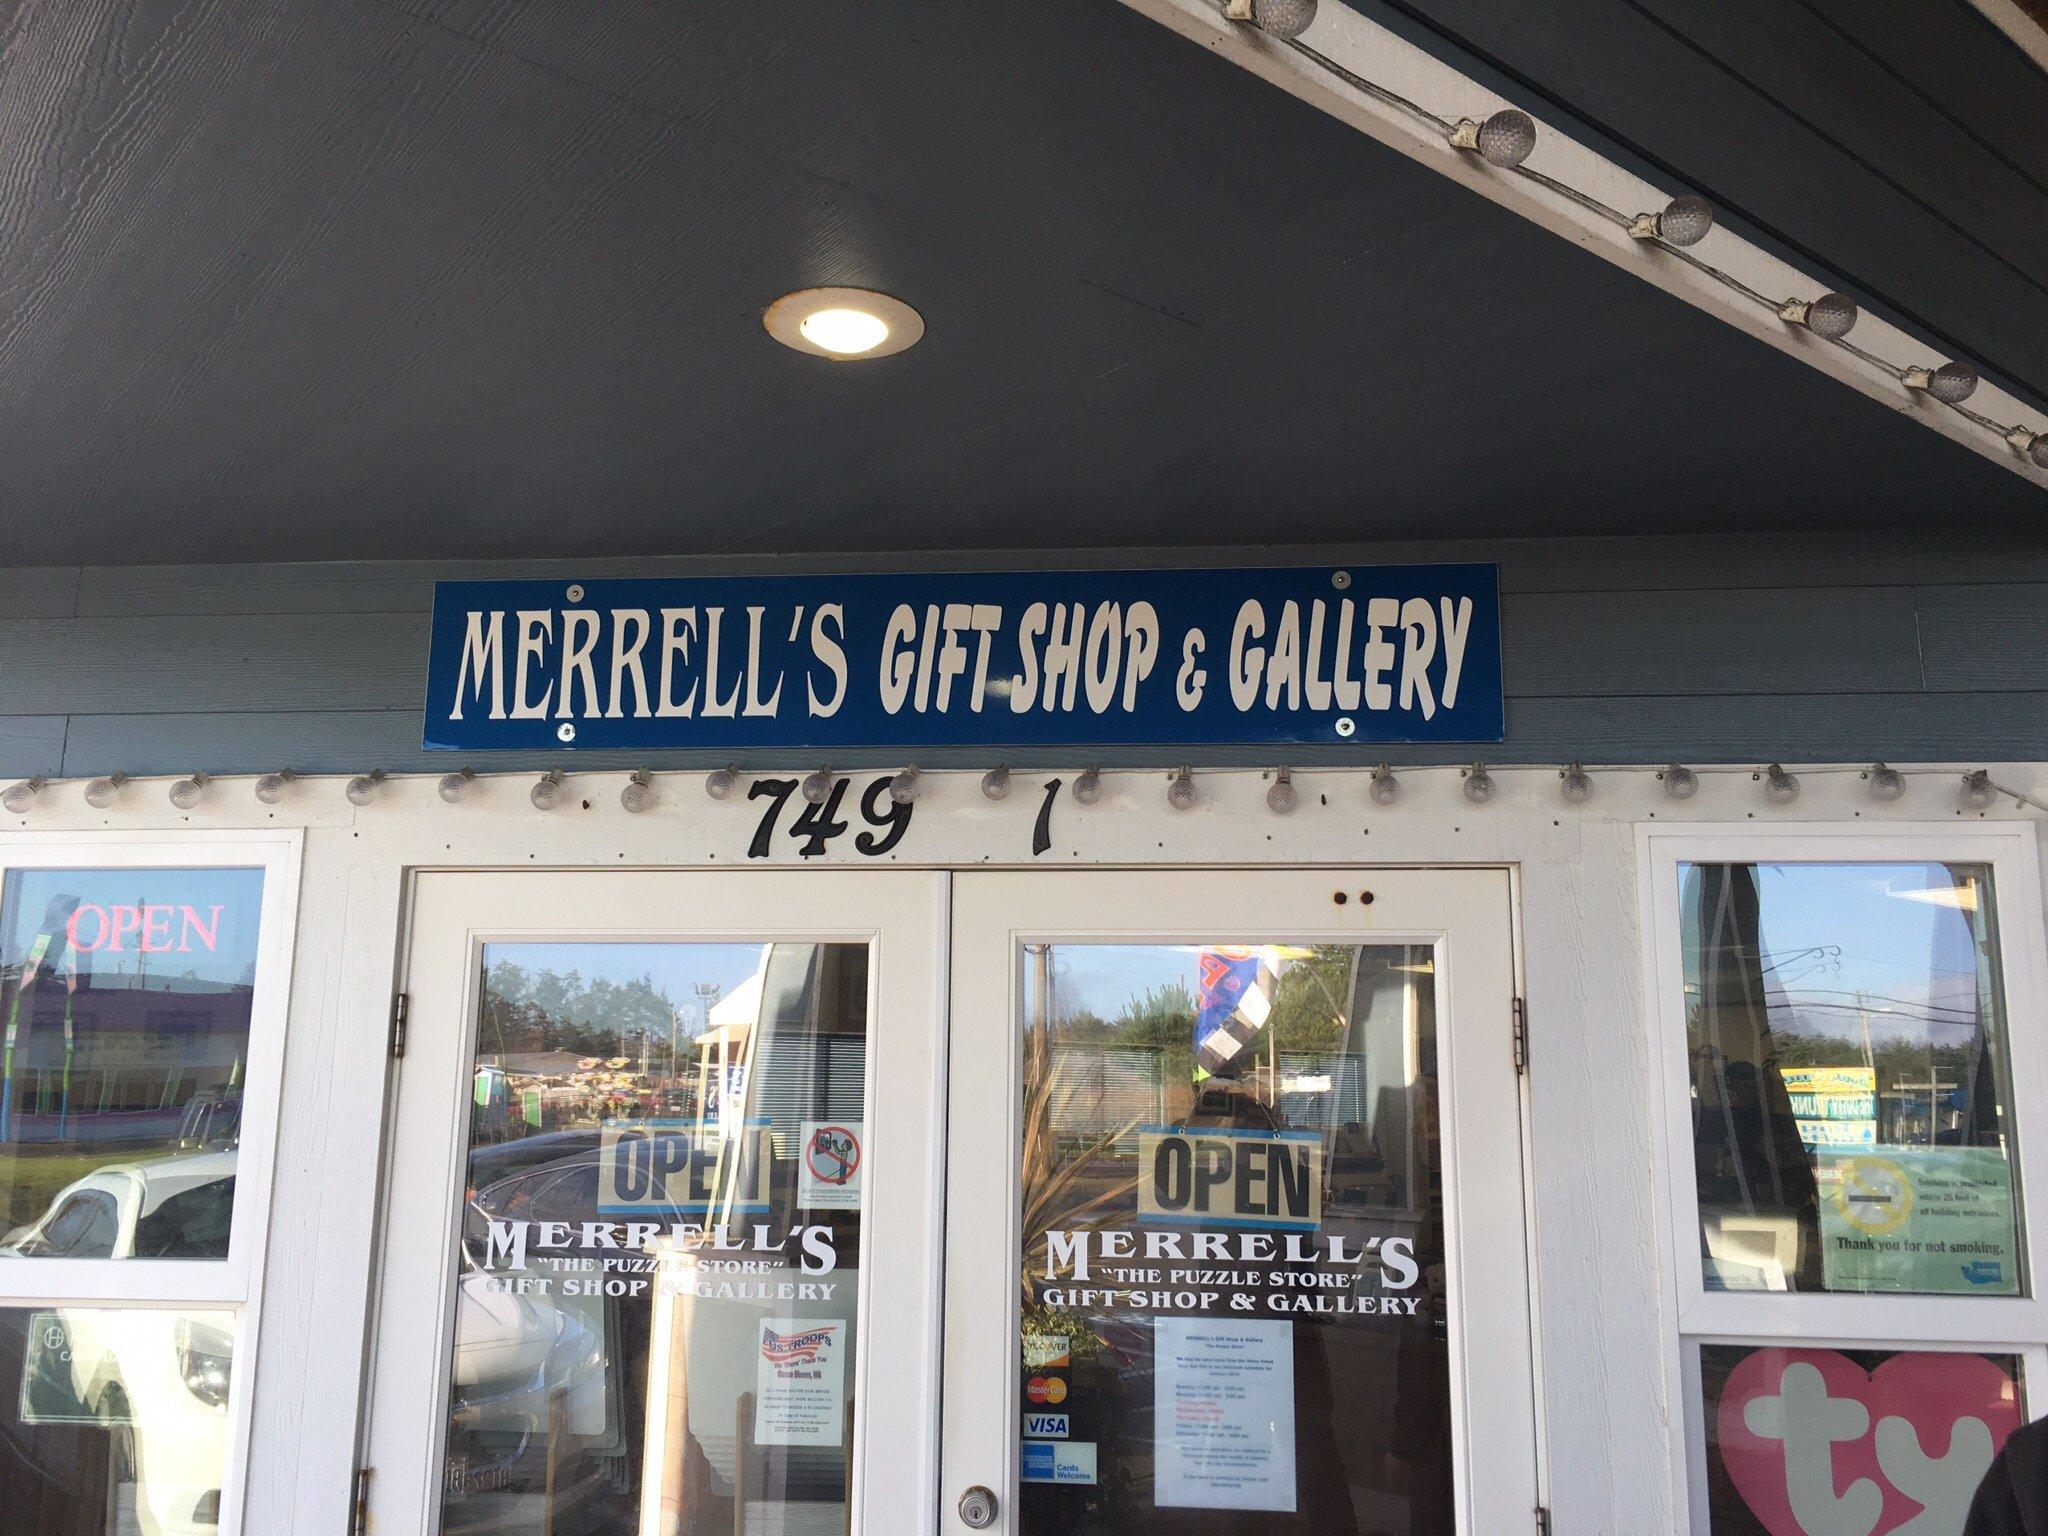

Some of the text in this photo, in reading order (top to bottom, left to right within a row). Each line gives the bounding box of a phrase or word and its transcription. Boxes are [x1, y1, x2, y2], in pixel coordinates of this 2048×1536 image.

[449, 596, 1473, 721] MERRELL'S GIFT SHOP & GALLERY
[748, 776, 914, 857] 749
[67, 903, 225, 953] OPEN
[614, 1130, 761, 1201] OPEN
[1154, 1137, 1310, 1218] OPEN
[483, 1221, 837, 1276] MERRELL'S
[1045, 1230, 1419, 1290] MERRELL'S
[1836, 1236, 2004, 1254] Thank you for not smoking.
[485, 1278, 552, 1296] GIFT
[562, 1279, 648, 1297] SHOP
[695, 1282, 838, 1300] GALLERY
[1043, 1288, 1422, 1315] GIFT SHOP & GALLERY
[1170, 1269, 1261, 1286] PUZZLE
[1028, 1417, 1067, 1433] VISA
[1744, 1361, 1994, 1536] ty
[1057, 1464, 1079, 1472] Cards
